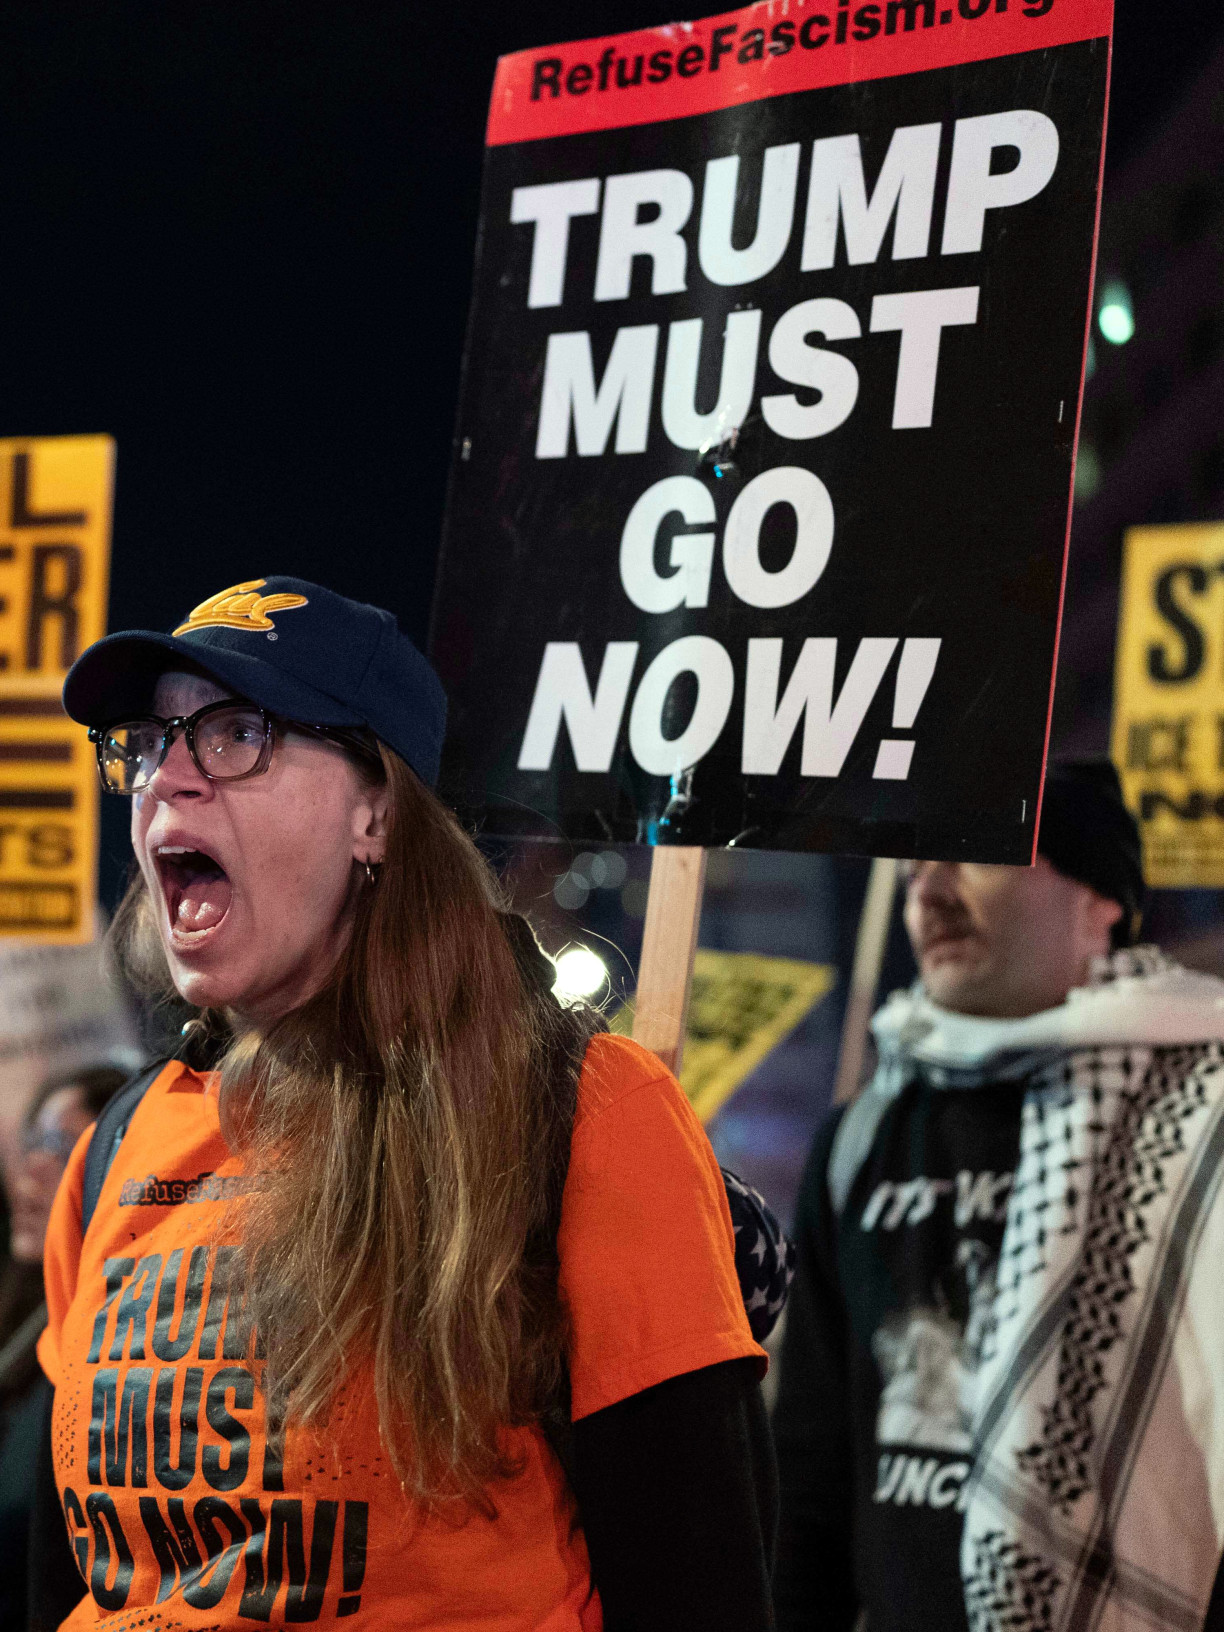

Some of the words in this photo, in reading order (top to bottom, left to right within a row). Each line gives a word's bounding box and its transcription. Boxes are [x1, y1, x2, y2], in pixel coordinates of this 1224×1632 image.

[510, 109, 1060, 309] TRUMP
[535, 286, 980, 460] MUST
[619, 466, 835, 614] GO
[517, 636, 942, 780] NOW!
[87, 1245, 274, 1364] TRUM
[138, 1495, 369, 1623] NOW!
